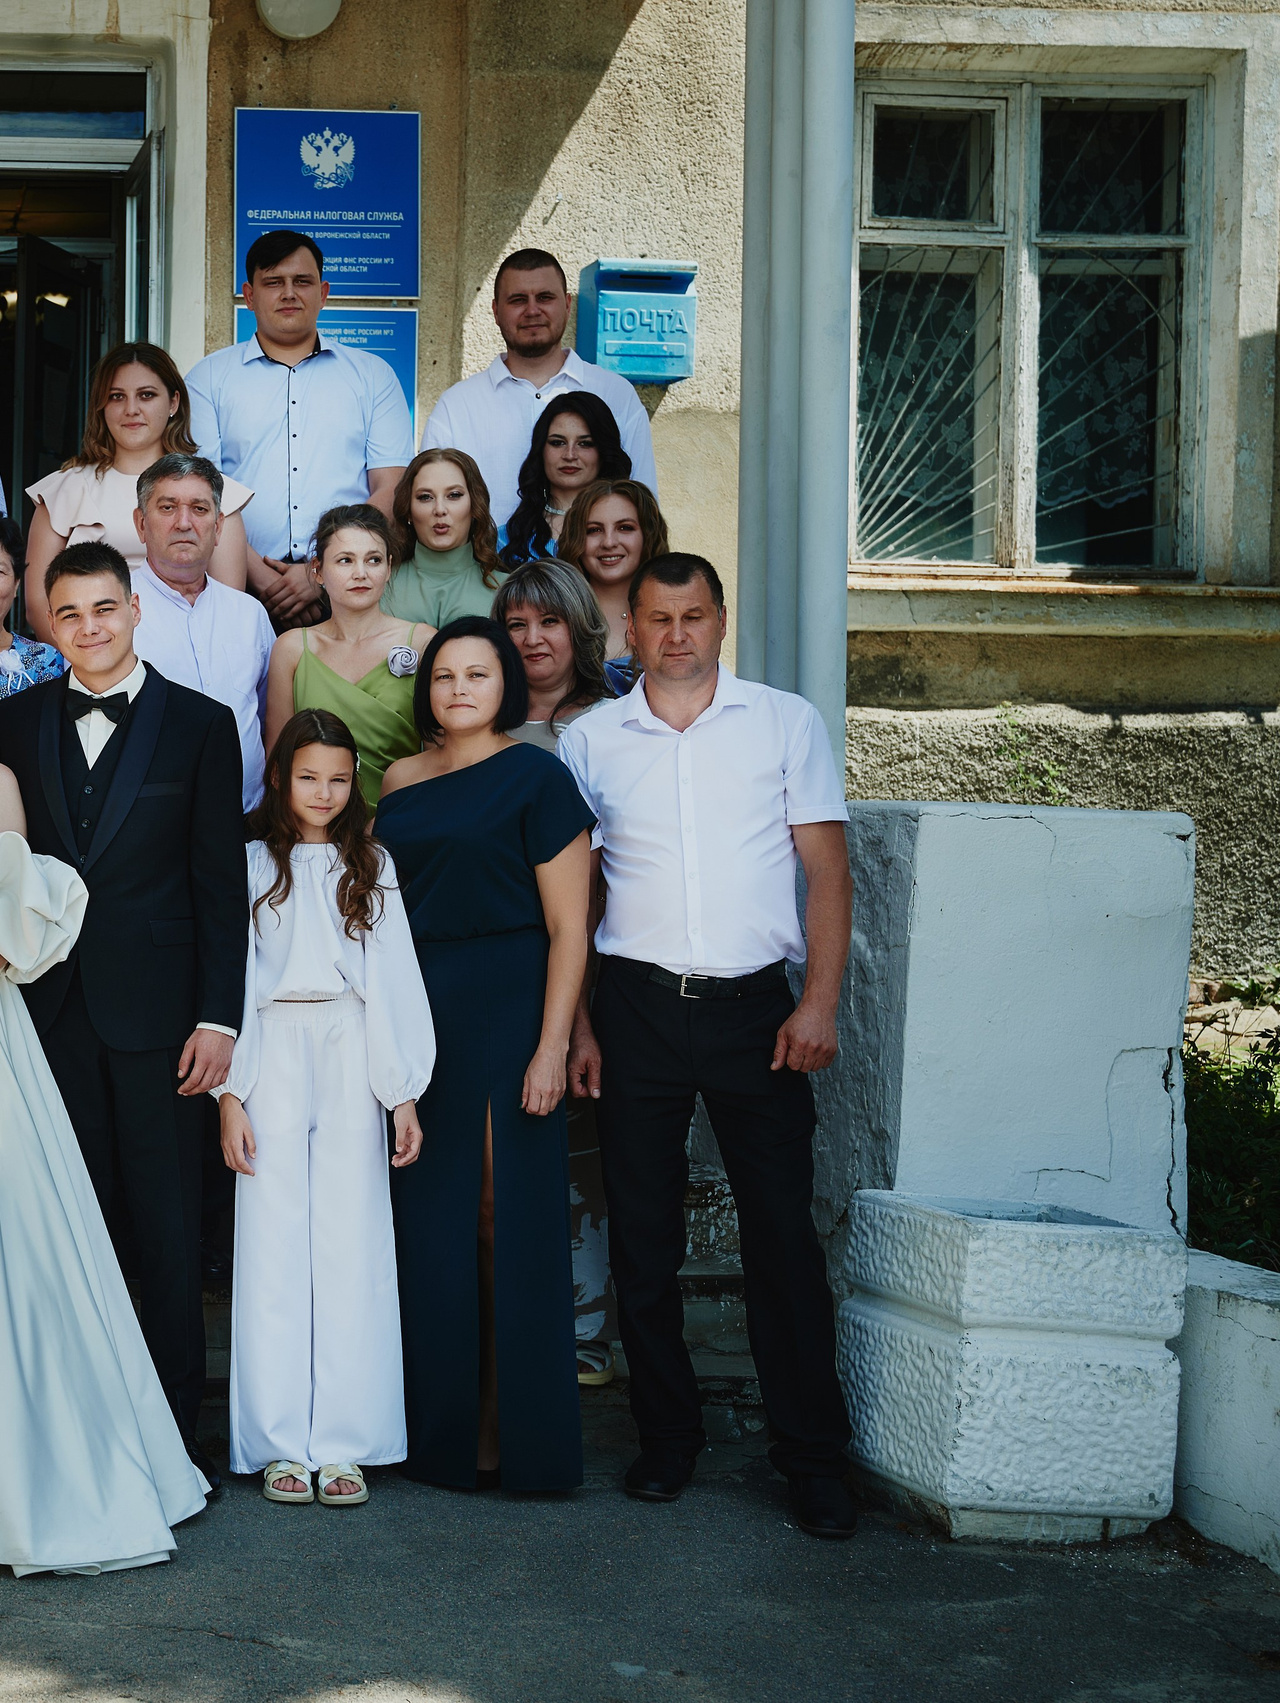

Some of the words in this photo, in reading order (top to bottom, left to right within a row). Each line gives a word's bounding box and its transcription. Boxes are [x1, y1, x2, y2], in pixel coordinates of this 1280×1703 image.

[247, 209, 312, 221] ФЕДЕРАЛЬНАЯ
[314, 210, 365, 221] НАЛОГОВАЯ
[367, 211, 404, 222] СЛУЖБА
[315, 231, 361, 240] ВОРОНЕЖСКОЙ
[339, 265, 368, 273] ОБЛАСТИ
[603, 308, 688, 333] ПОЧТА
[358, 328, 382, 336] РОССИИ
[340, 336, 368, 344] ОБЛАСТИ
